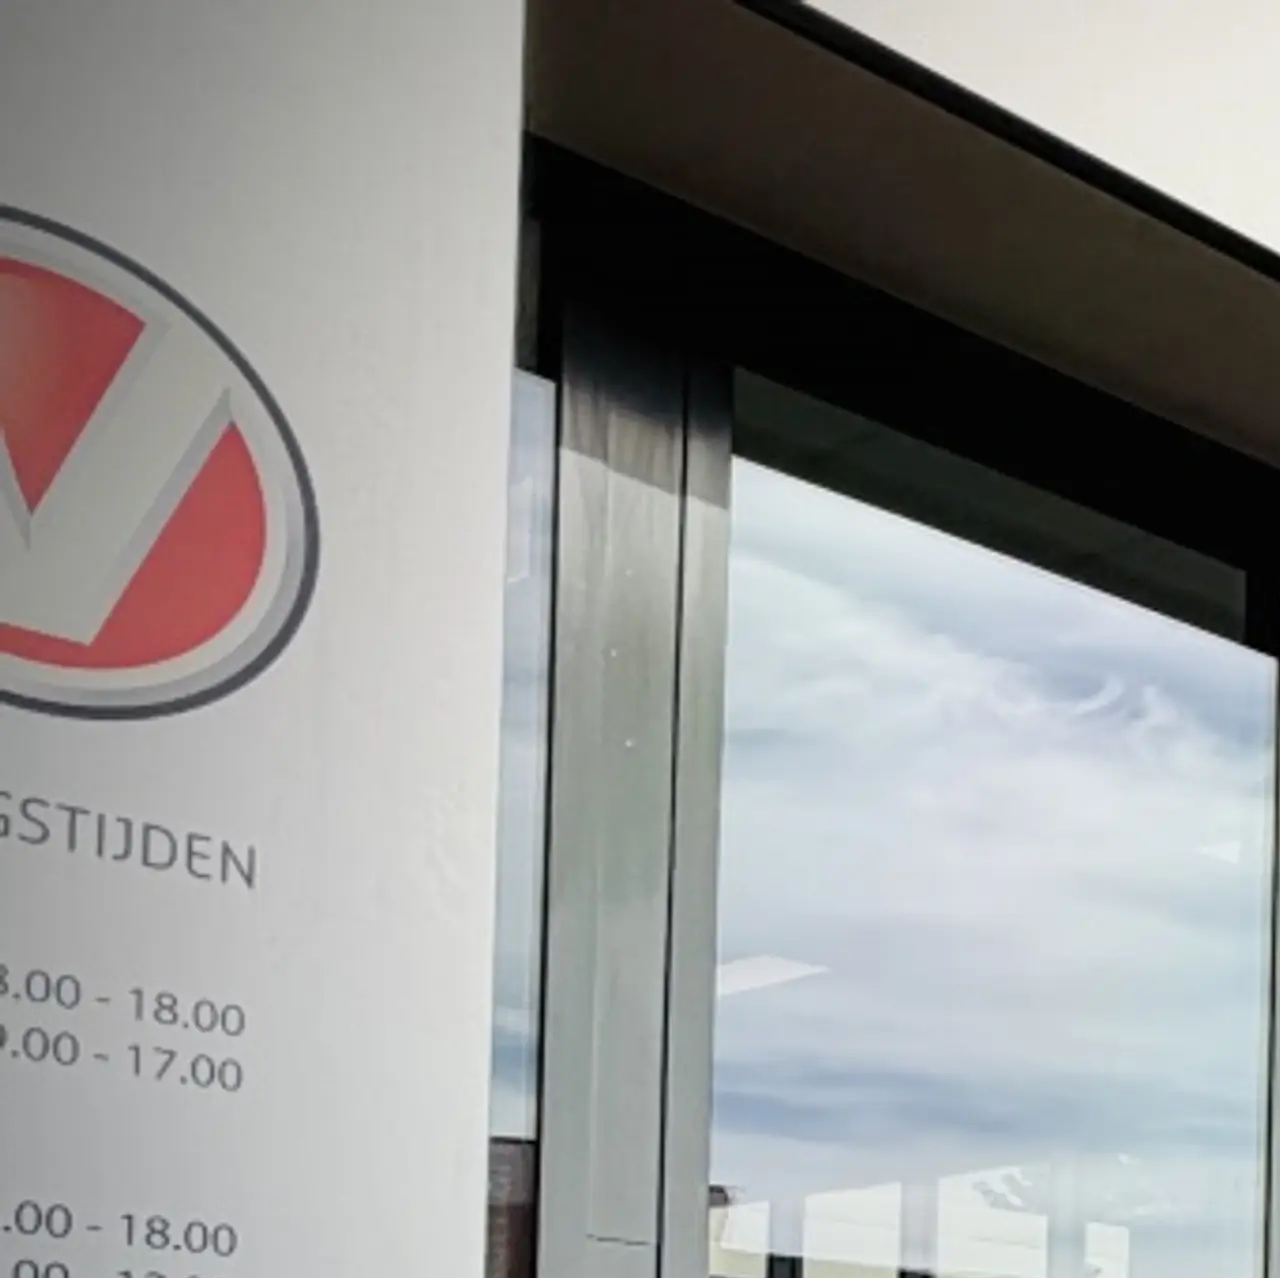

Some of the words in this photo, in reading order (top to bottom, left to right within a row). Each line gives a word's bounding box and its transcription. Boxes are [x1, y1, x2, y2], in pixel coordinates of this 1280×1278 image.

[128, 986, 245, 1037] 18.00
[127, 1043, 243, 1092] 17.00
[120, 1213, 238, 1257] 18.00
